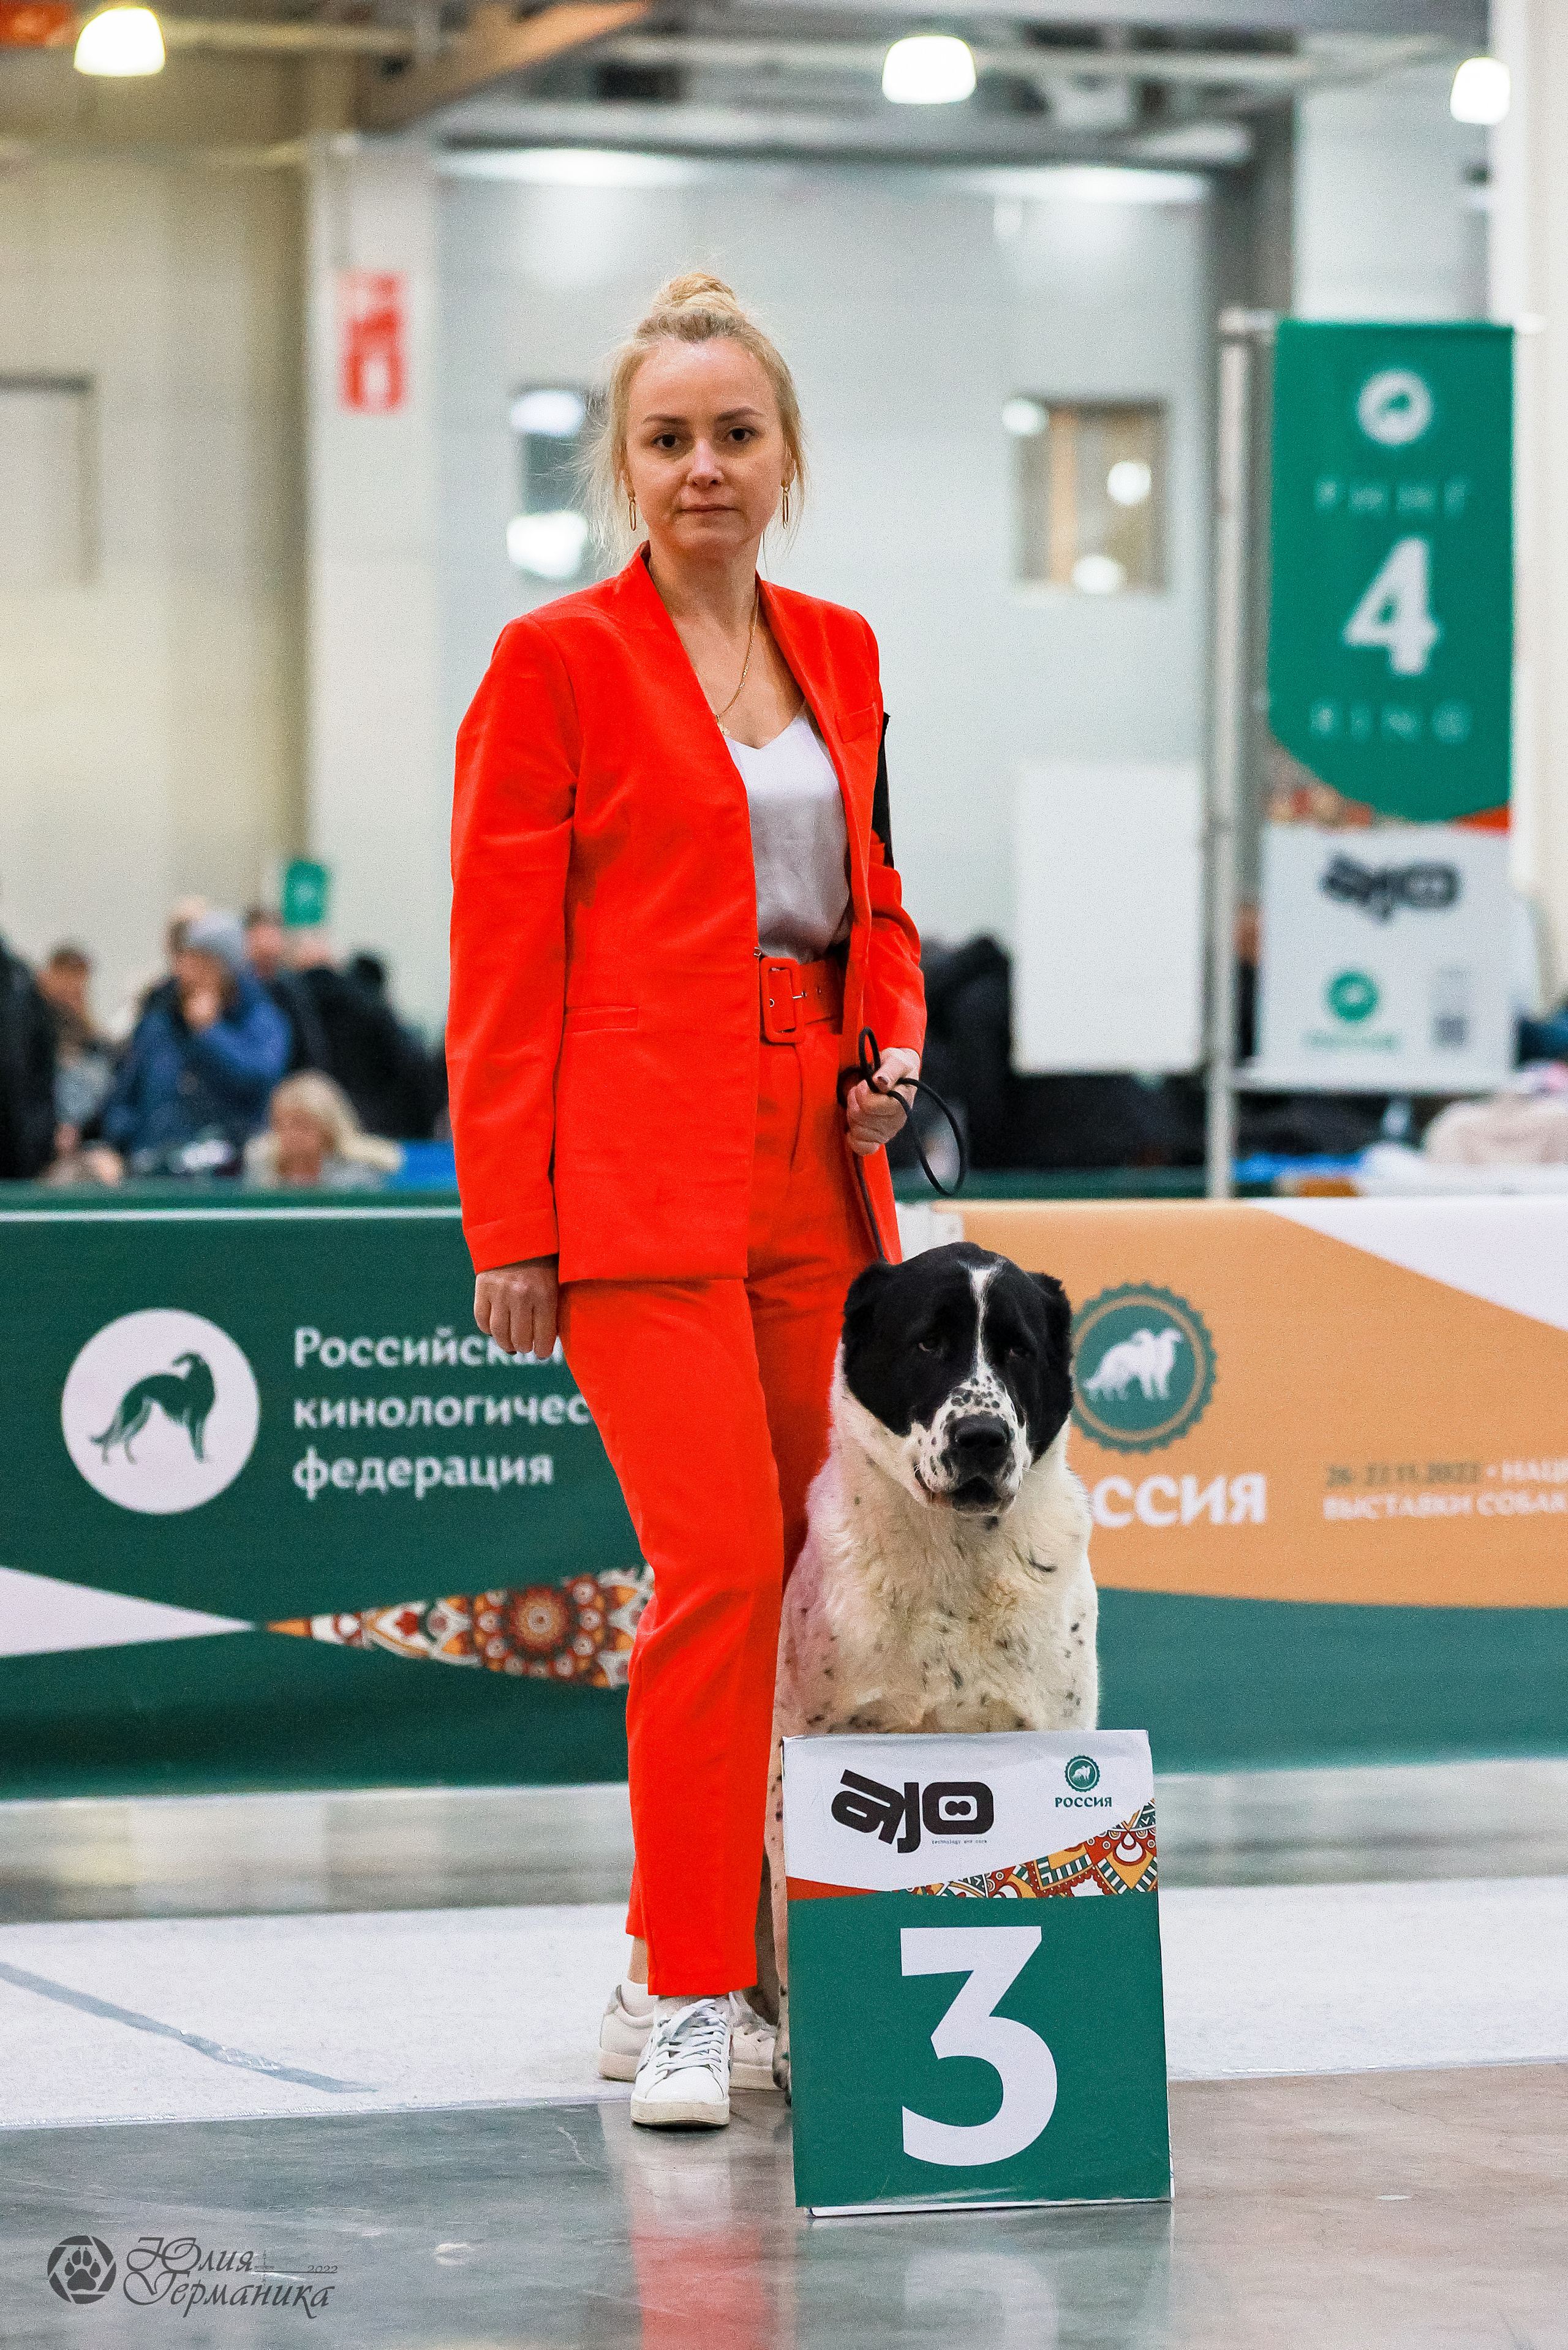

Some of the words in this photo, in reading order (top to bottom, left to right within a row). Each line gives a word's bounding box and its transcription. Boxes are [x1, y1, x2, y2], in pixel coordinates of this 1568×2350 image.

[1344, 537, 1440, 676] 4
[294, 1326, 565, 1368] Российск
[294, 1395, 591, 1428] кинологичес
[292, 1445, 553, 1500] федерация
[1093, 1473, 1266, 1527] ССИЯ
[1055, 1796, 1112, 1807] РОССИЯ
[900, 1926, 1057, 2166] 3
